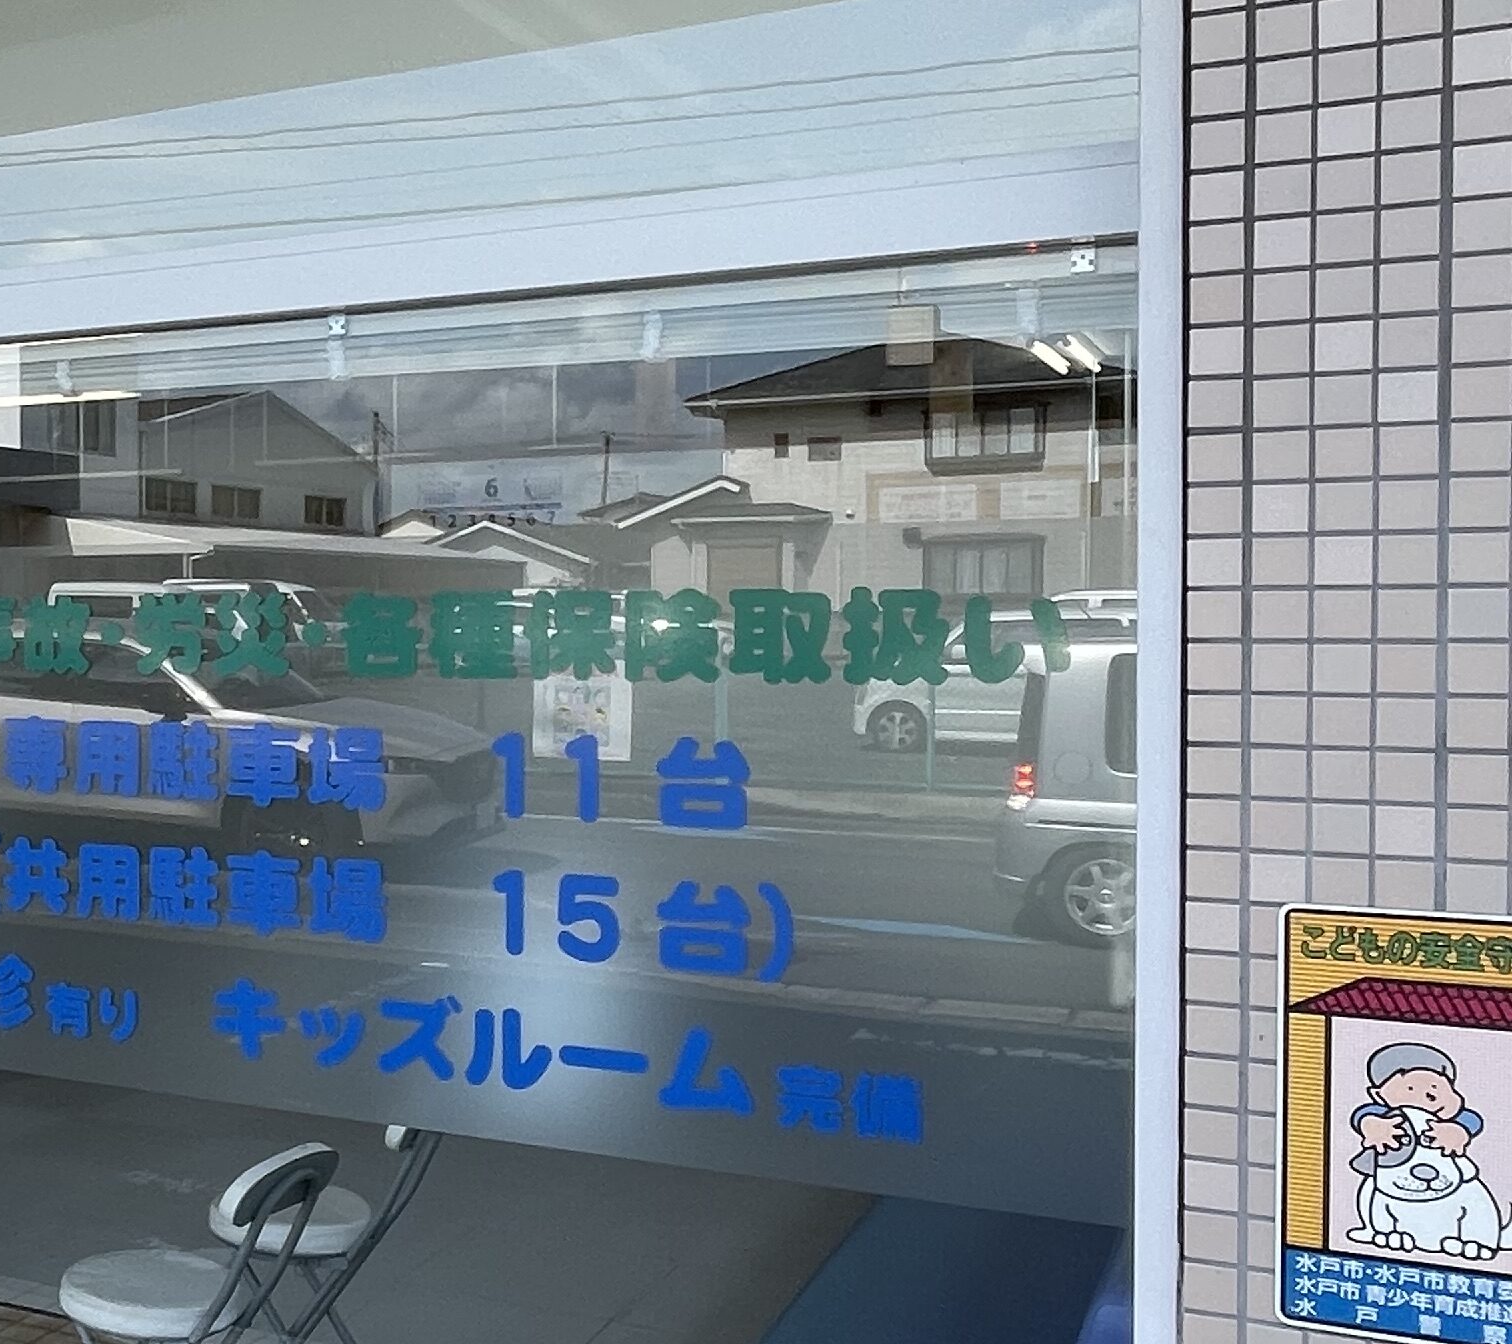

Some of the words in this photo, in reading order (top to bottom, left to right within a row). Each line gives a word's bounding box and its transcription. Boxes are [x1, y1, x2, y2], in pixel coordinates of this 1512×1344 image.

[483, 477, 499, 498] 6
[448, 514, 457, 528] 2
[2, 716, 387, 812] 専用駐車場
